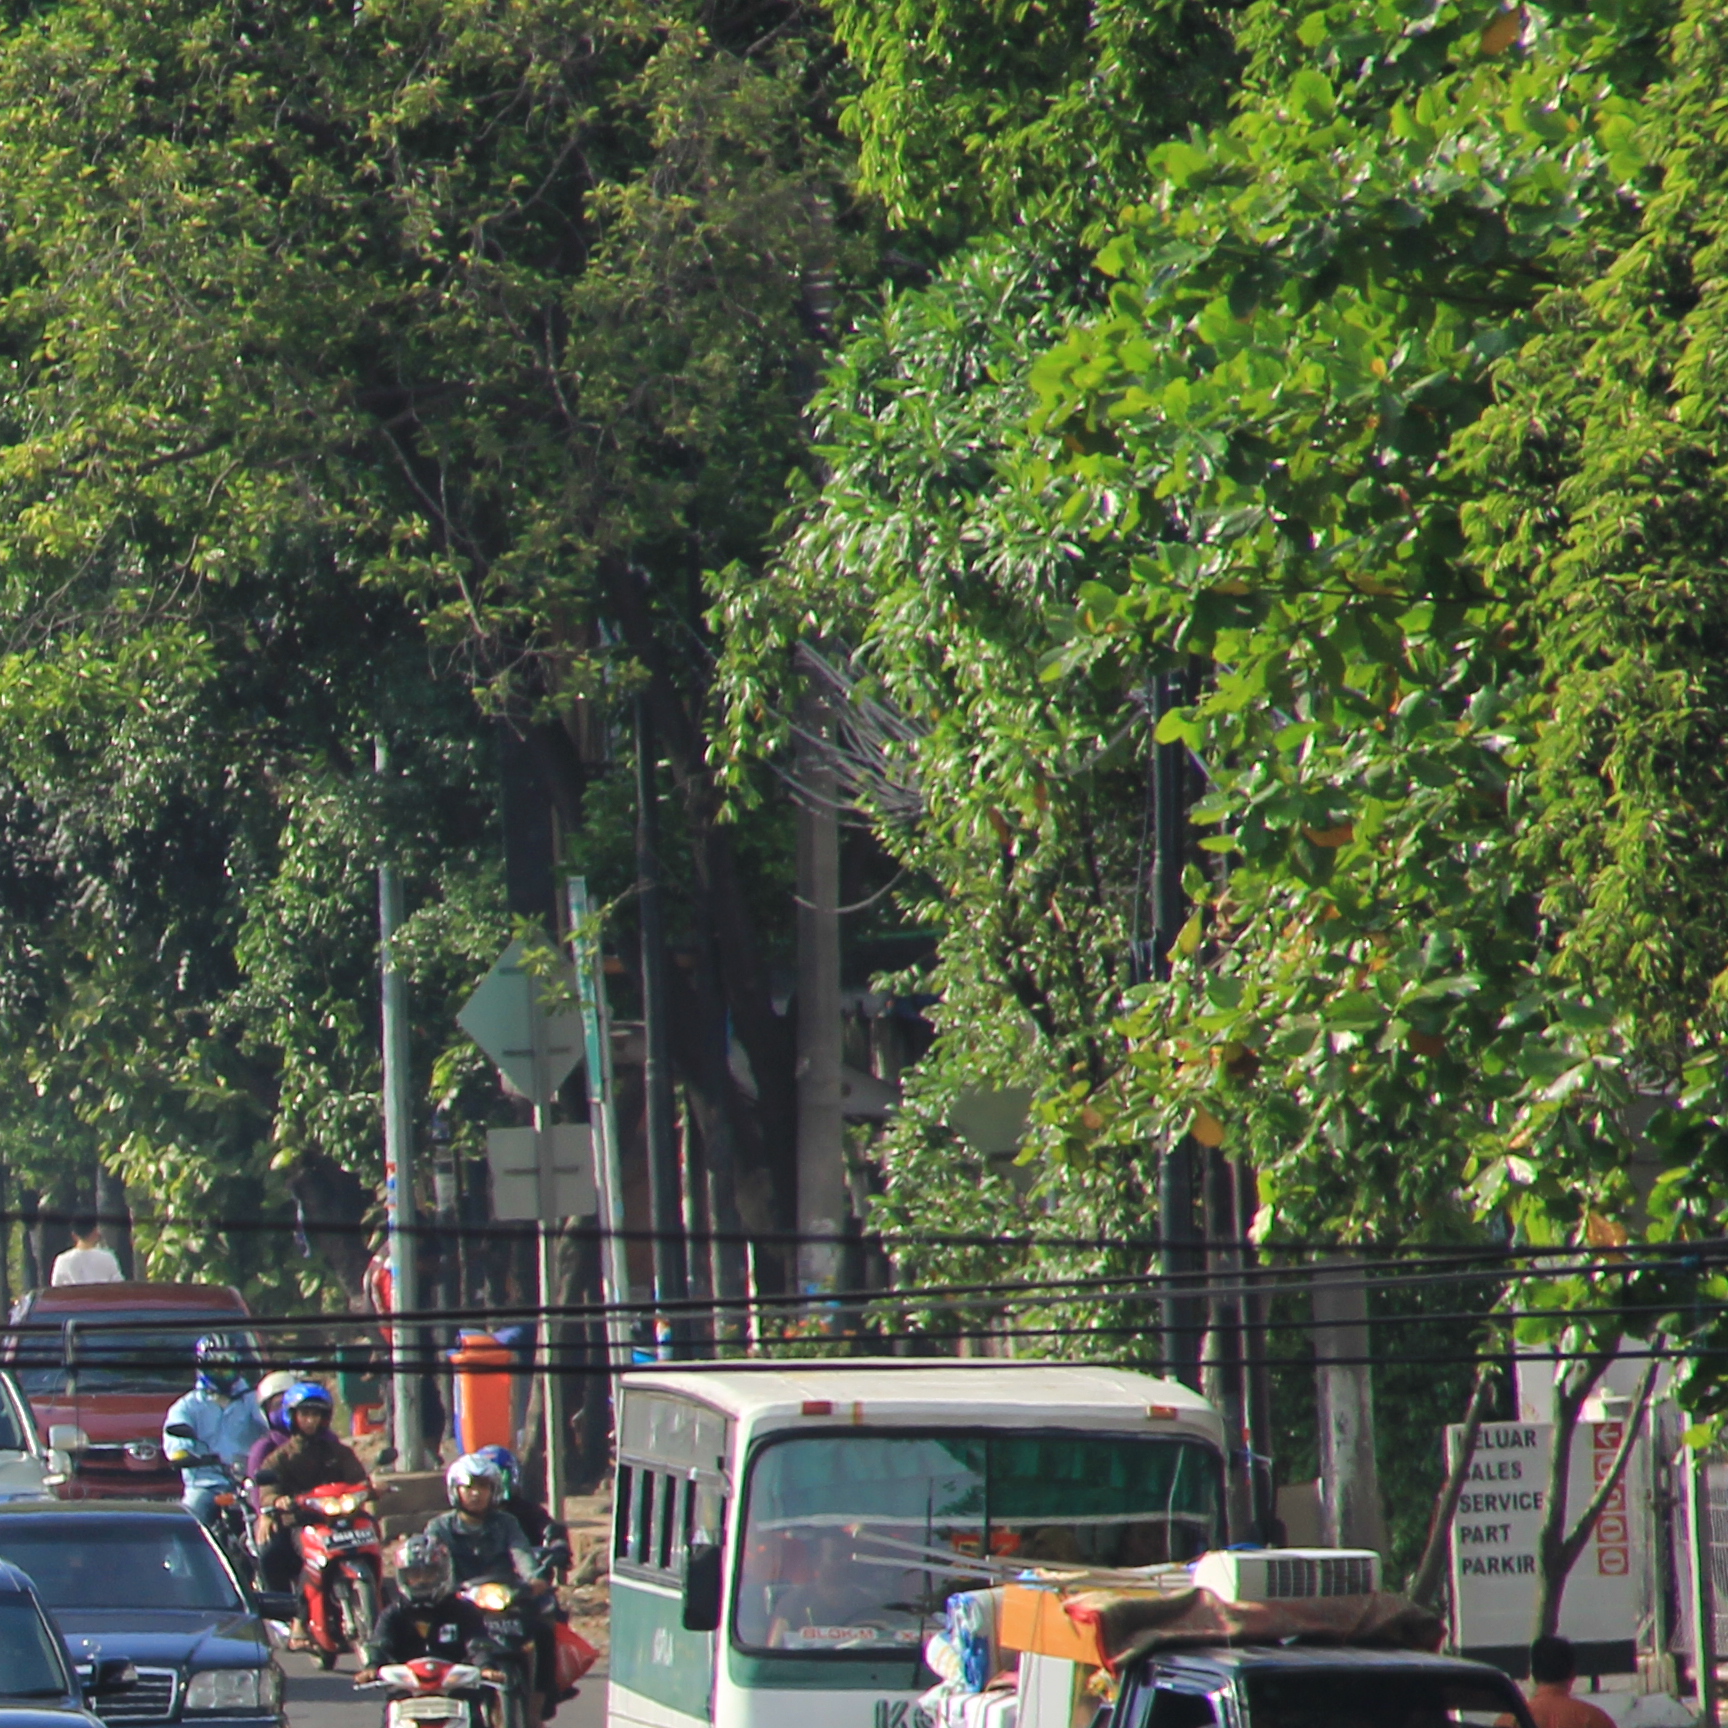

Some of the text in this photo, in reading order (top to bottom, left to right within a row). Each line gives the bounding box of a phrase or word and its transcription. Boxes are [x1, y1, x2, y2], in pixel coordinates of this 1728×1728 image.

[1457, 1428, 1537, 1449] ELUAR
[1464, 1461, 1523, 1482] ALES
[1458, 1491, 1544, 1514] SERVICE
[1460, 1523, 1512, 1544] PART
[1461, 1554, 1536, 1576] PARKIR
